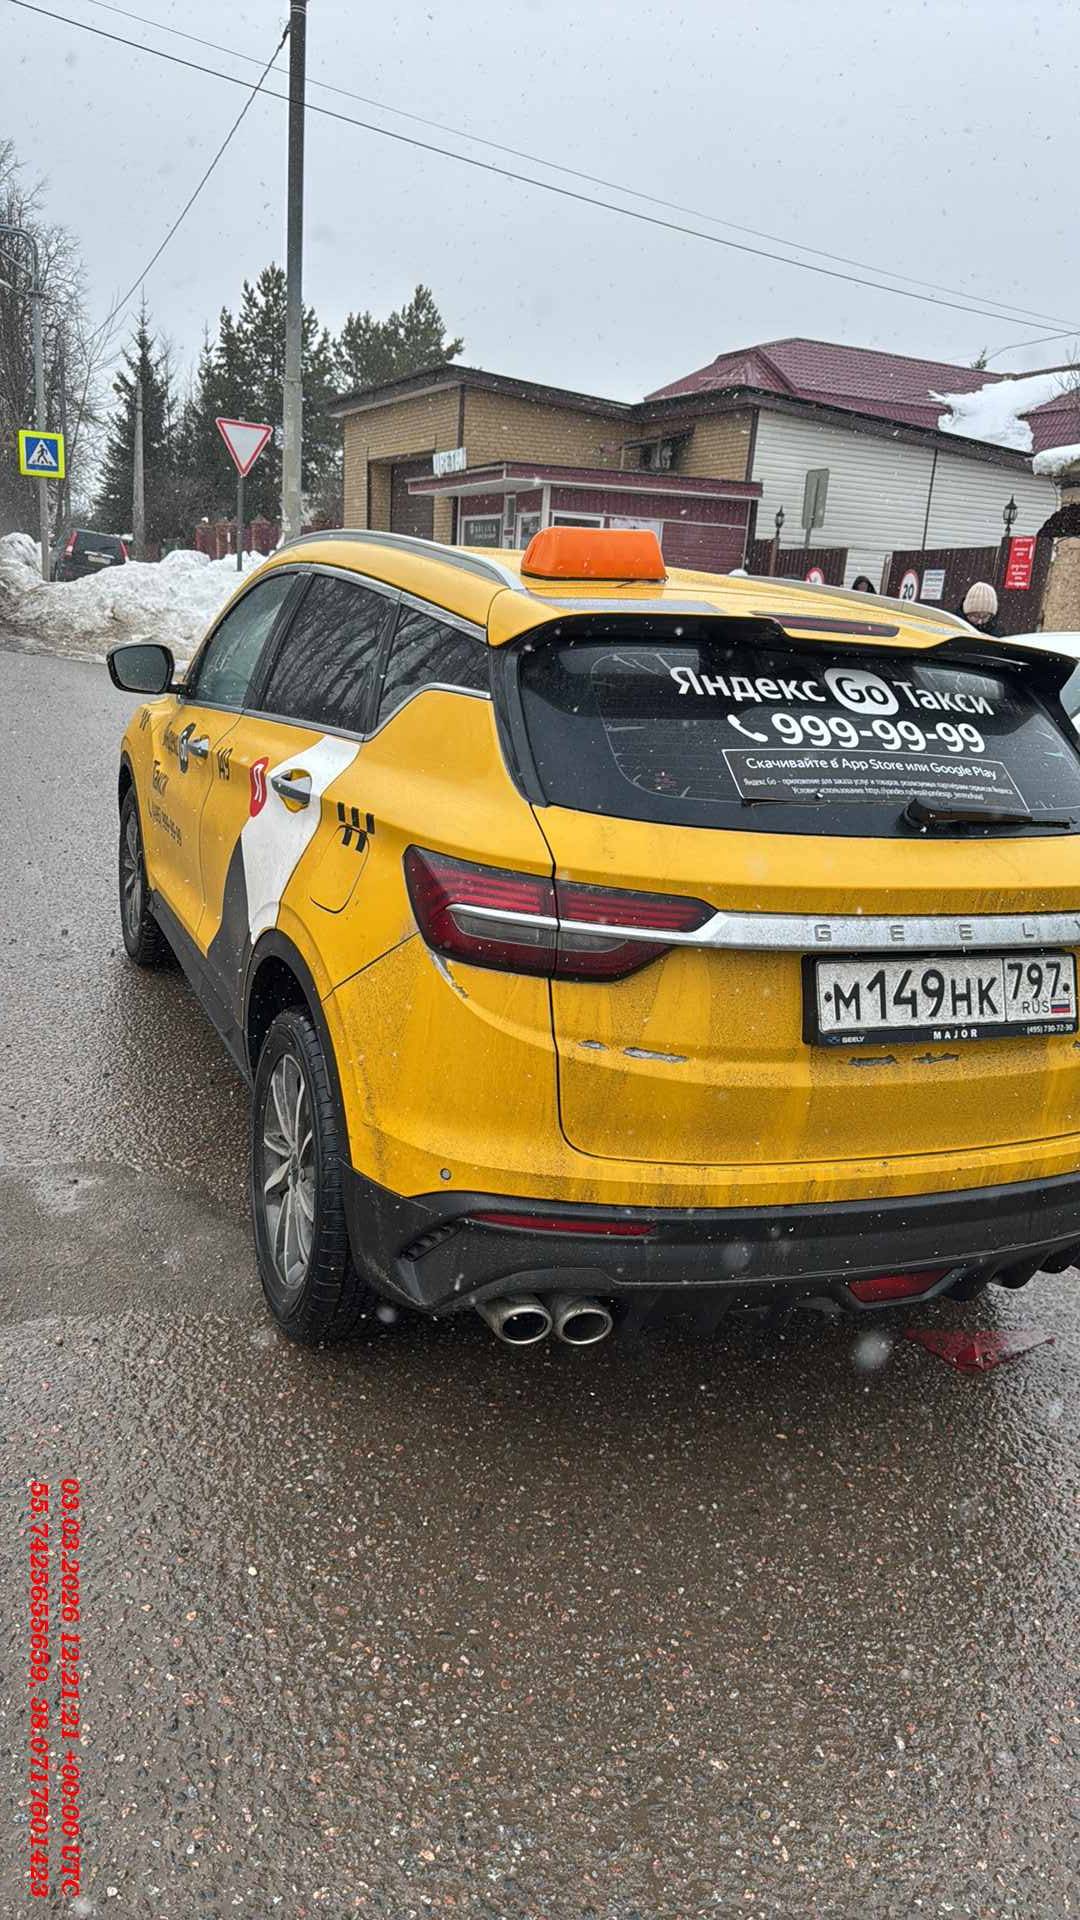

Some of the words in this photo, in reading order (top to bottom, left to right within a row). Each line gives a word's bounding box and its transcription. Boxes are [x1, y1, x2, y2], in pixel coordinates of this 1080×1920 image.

[902, 584, 915, 600] 20
[670, 666, 827, 703] Яндекс
[835, 676, 890, 706] Go
[892, 680, 995, 716] Такси
[771, 712, 986, 753] 999-99-99
[745, 756, 829, 769] Скачивайте
[830, 758, 839, 769] в
[842, 757, 868, 771] App
[868, 758, 904, 771] Store
[905, 762, 930, 773] или
[930, 761, 972, 777] Google
[972, 765, 997, 781] Play
[814, 920, 1080, 942] GEEL
[833, 968, 999, 1021] М149НК
[1007, 962, 1061, 1000] 797
[1022, 1001, 1050, 1014] RUS
[933, 1028, 978, 1040] MAJOR
